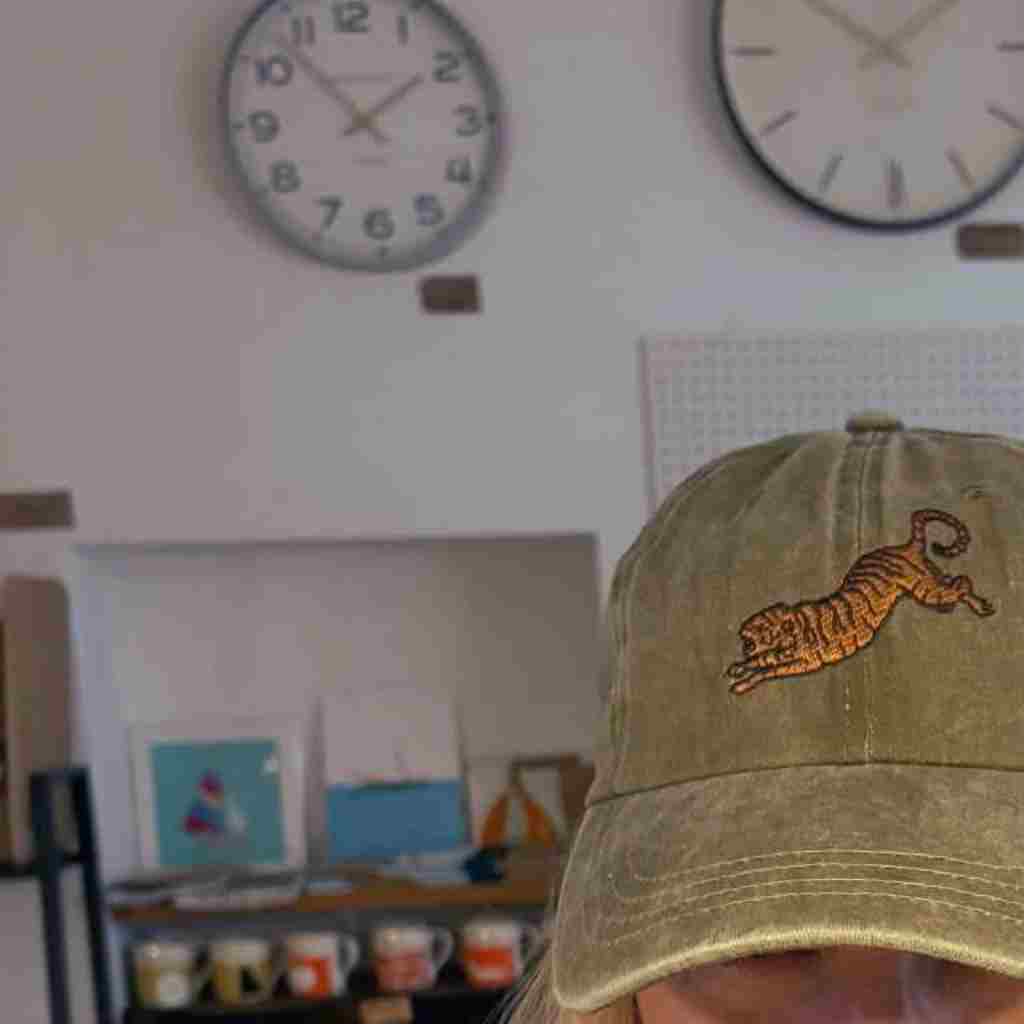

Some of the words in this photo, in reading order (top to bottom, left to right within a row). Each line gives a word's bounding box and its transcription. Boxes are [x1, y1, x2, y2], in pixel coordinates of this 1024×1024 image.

[291, 15, 316, 45] 11
[397, 15, 410, 45] 1
[255, 54, 293, 86] 10
[432, 50, 461, 83] 2
[249, 109, 280, 143] 9
[453, 104, 483, 137] 3
[269, 161, 301, 193] 8
[444, 157, 471, 184] 4
[317, 195, 343, 230] 7
[362, 208, 395, 240] 6
[413, 194, 445, 226] 5
